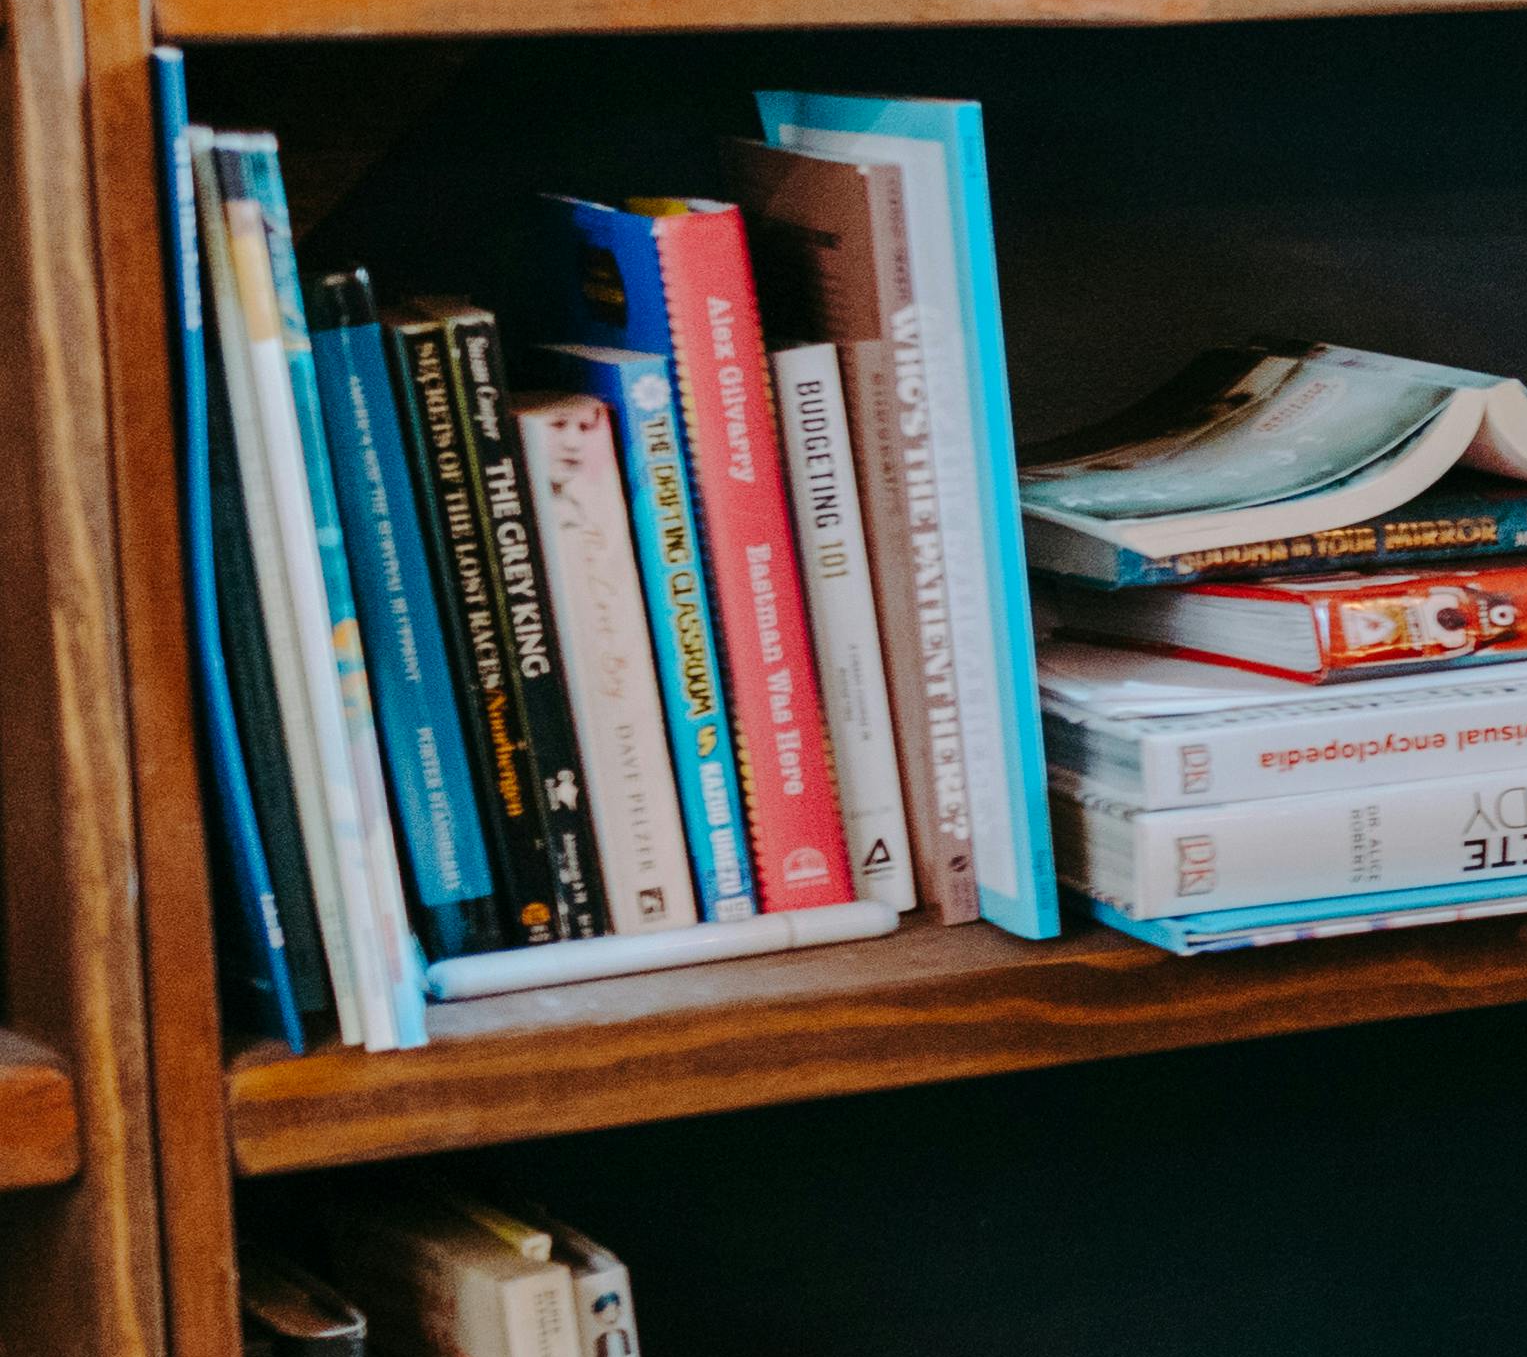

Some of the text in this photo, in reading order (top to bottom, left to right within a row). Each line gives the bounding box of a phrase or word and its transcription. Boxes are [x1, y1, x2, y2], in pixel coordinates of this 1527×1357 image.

[707, 295, 757, 485] Alex Gilvarry
[796, 379, 851, 581] BUDGETING 101
[416, 341, 502, 689] SECRETS OF THE LOST RACES
[485, 457, 551, 679] THE GREY KING
[644, 418, 714, 716] THE DRIFTING CLASSROOM
[900, 440, 940, 532] THE
[1384, 515, 1499, 551] MIRROR
[746, 542, 807, 798] Eastman Was Here
[911, 532, 958, 706] PATIENT
[611, 725, 642, 790] DAVE
[928, 706, 971, 841] HERE?
[1258, 732, 1447, 773] encyclopedia
